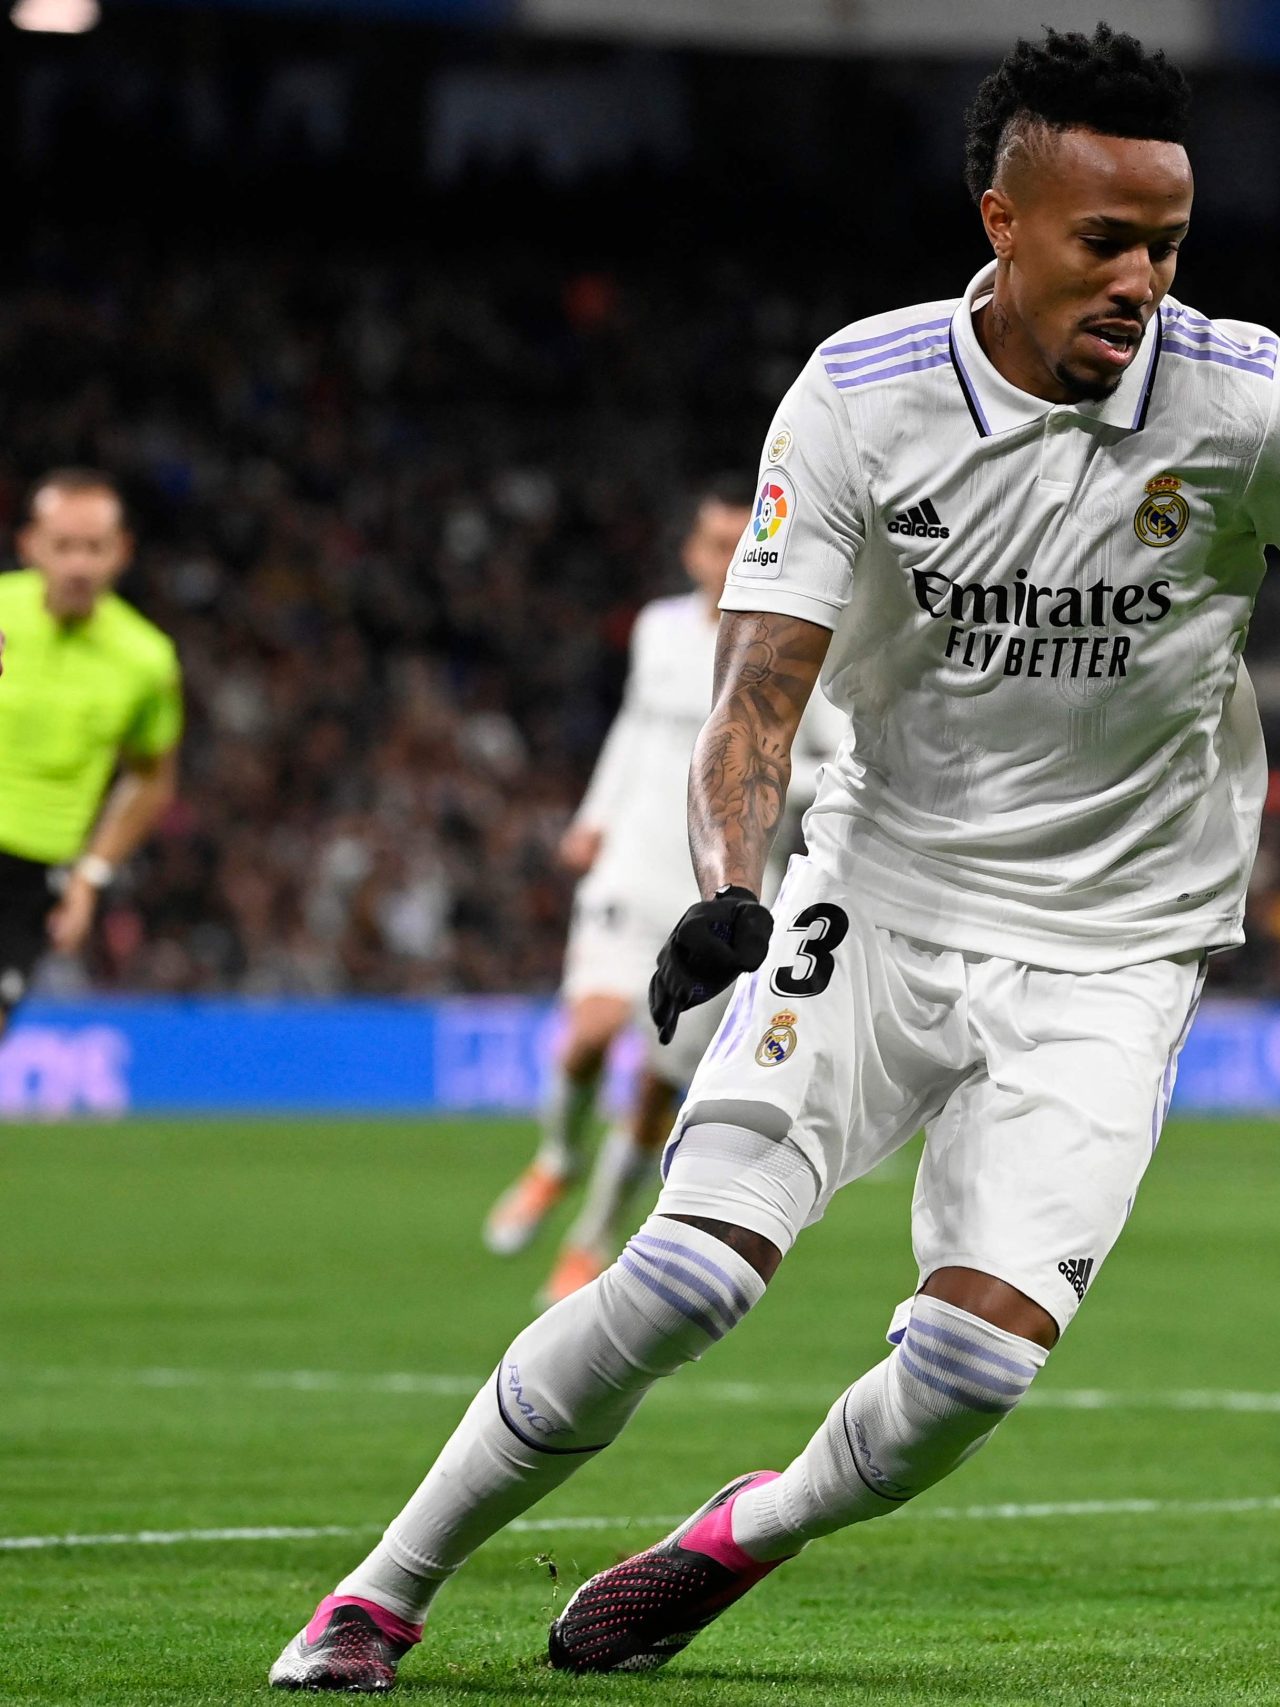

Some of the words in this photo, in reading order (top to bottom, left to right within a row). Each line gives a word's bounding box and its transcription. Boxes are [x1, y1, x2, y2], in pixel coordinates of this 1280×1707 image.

[887, 520, 950, 539] adidas
[743, 547, 779, 566] LaLiga
[912, 568, 1172, 628] Emirates
[945, 625, 1003, 672] FLY
[1003, 635, 1131, 678] BETTER
[769, 902, 849, 998] 3
